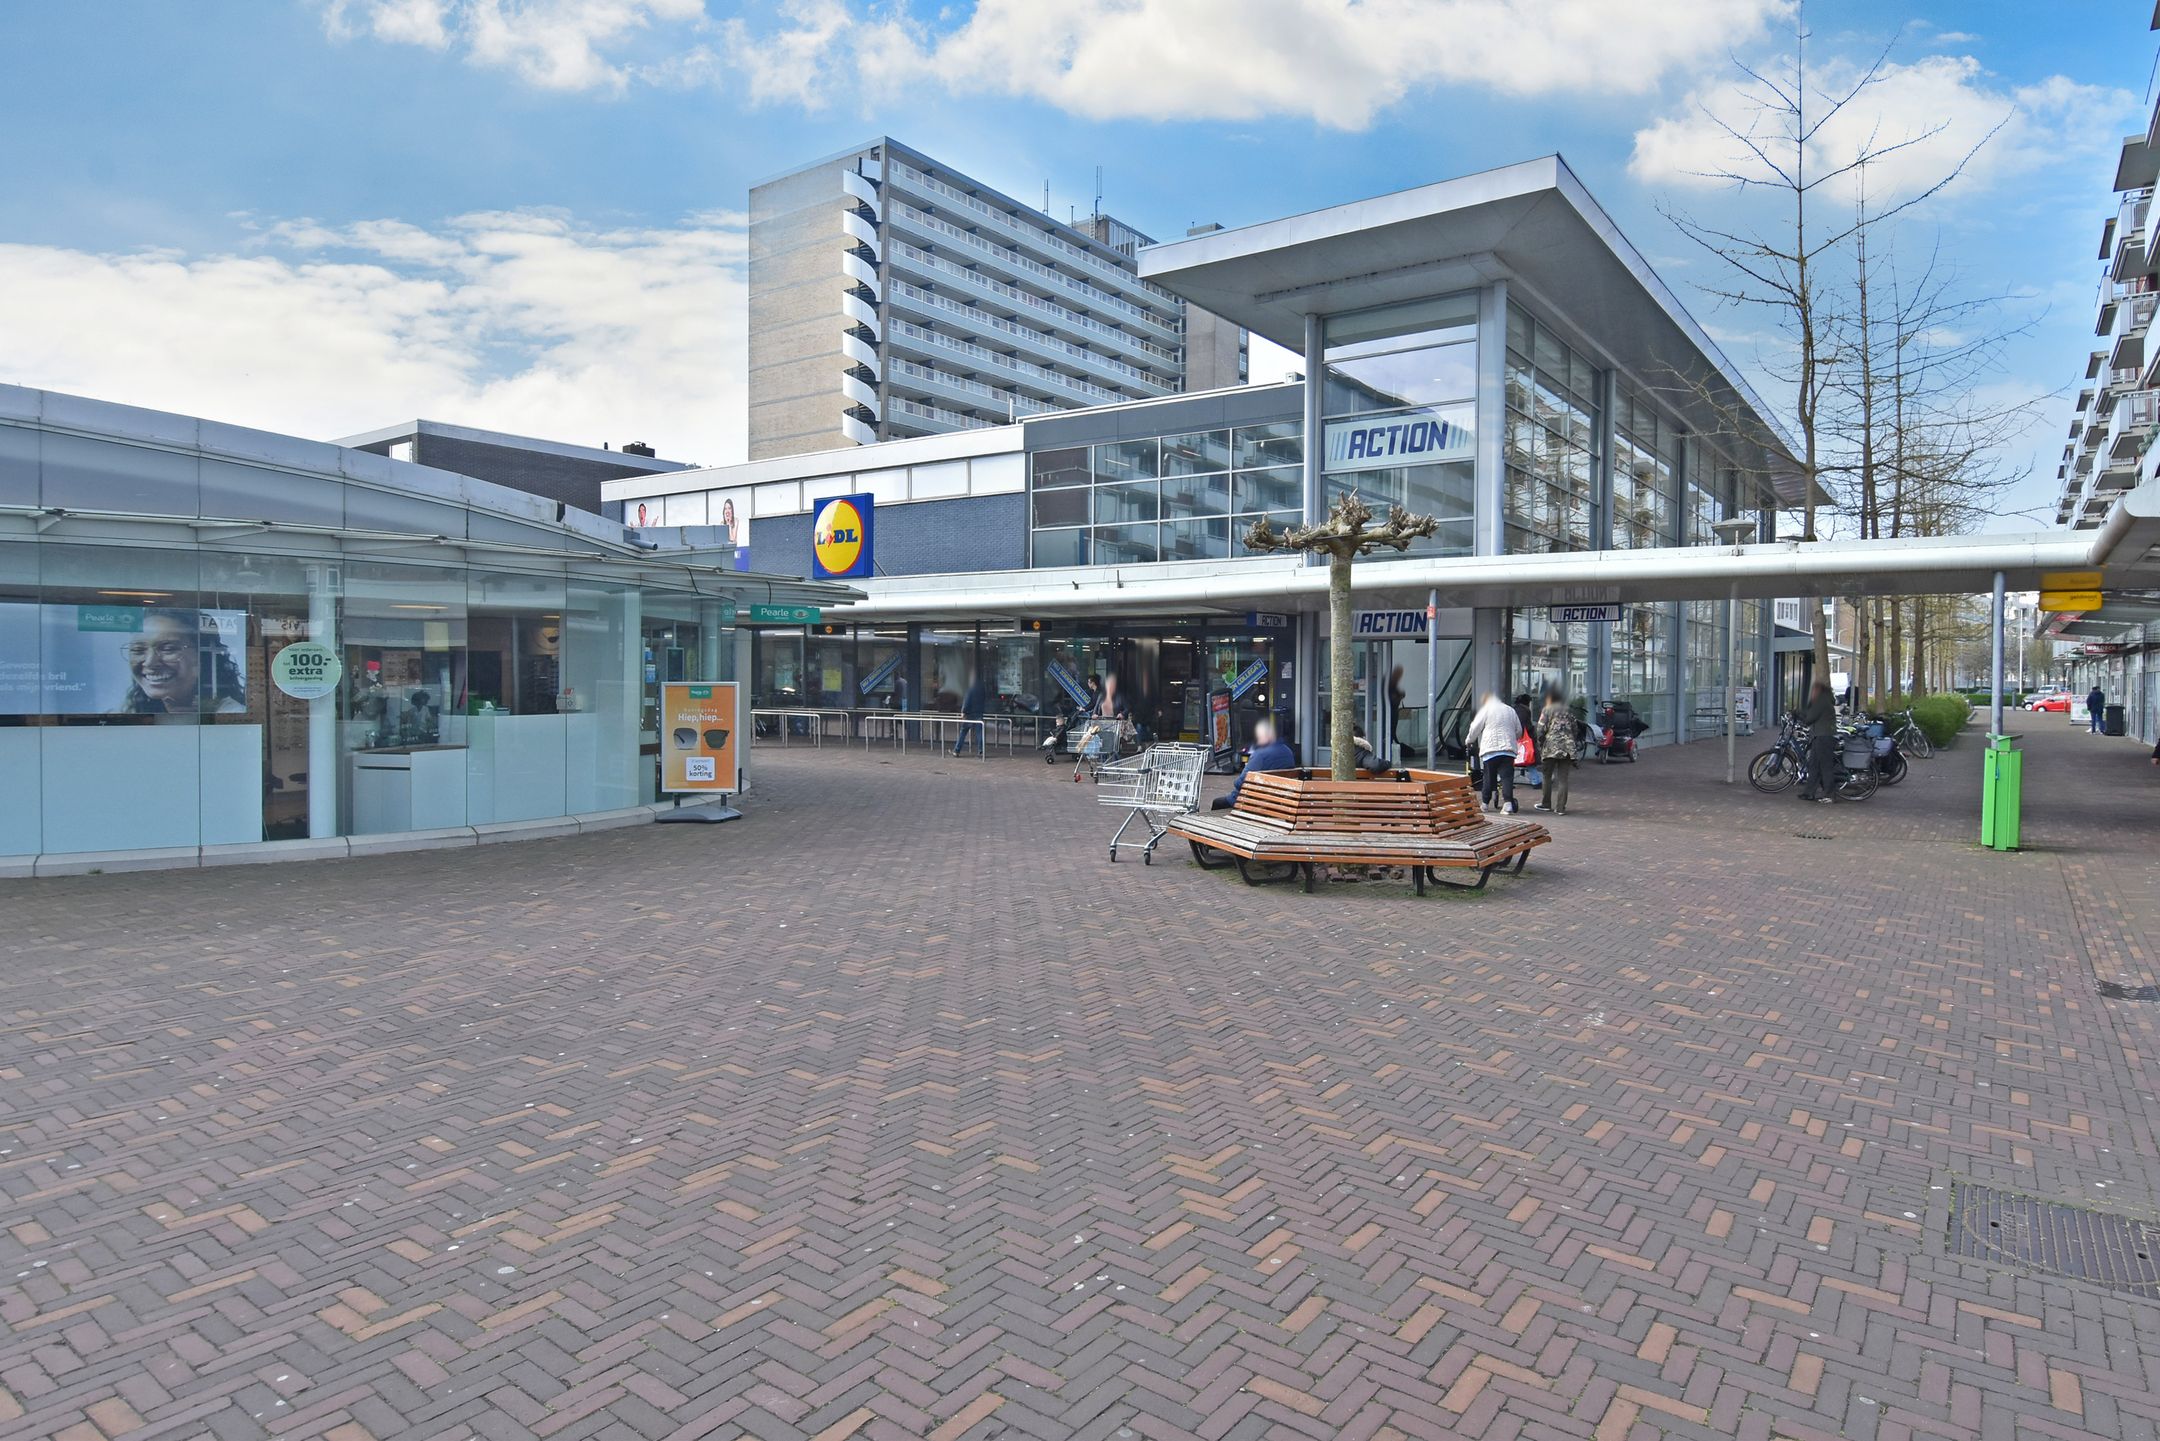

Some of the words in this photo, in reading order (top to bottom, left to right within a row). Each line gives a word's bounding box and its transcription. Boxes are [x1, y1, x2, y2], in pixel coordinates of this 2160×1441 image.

[1348, 420, 1449, 459] ACTION
[760, 607, 789, 616] Pearle
[1563, 607, 1607, 620] ACTION
[85, 612, 115, 621] Pearle
[1261, 615, 1282, 626] ACTION
[1359, 612, 1428, 633] ACTION
[48, 671, 67, 680] bril
[288, 667, 323, 675] extra
[689, 770, 713, 778] korting
